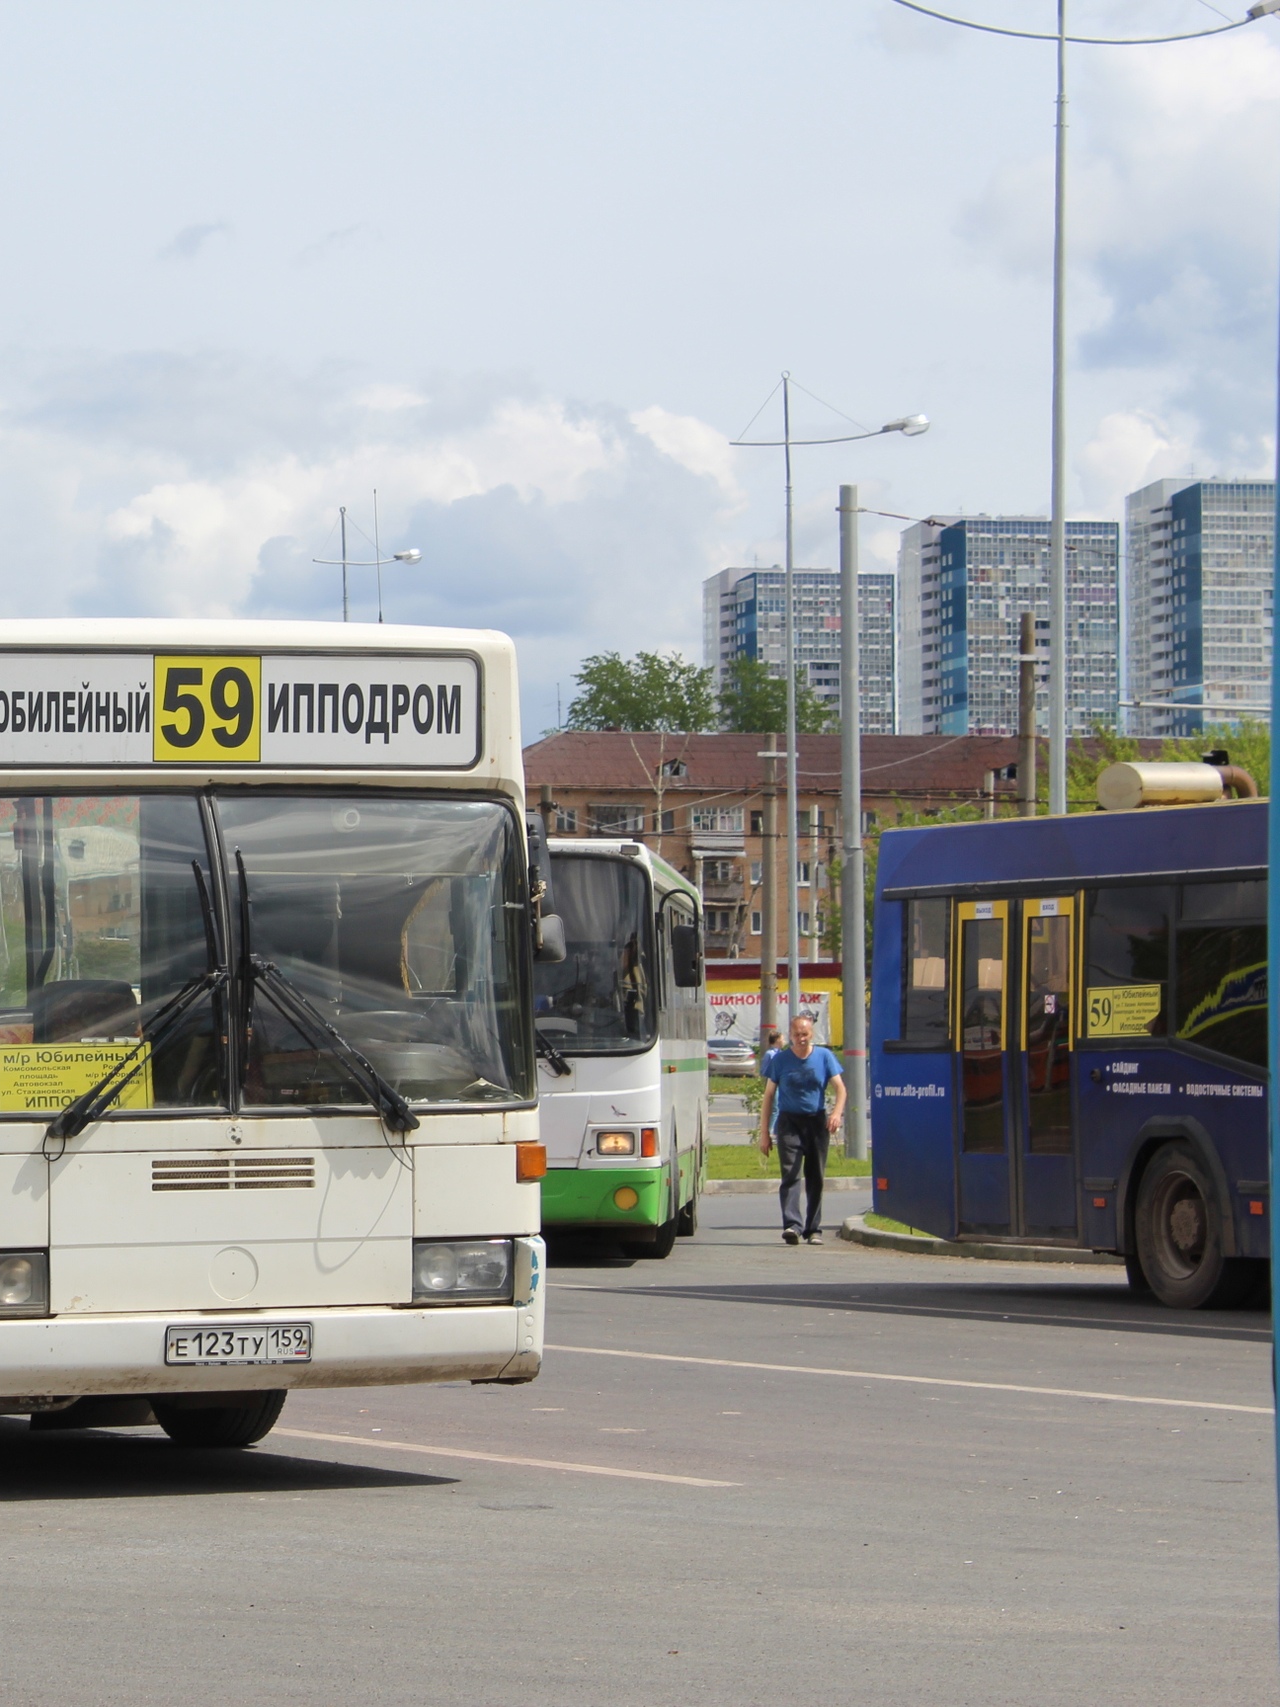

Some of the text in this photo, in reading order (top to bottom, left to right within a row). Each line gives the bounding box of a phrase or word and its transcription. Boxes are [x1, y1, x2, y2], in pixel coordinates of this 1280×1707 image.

[161, 667, 255, 748] 59
[268, 683, 461, 744] ИППОДРОМ
[710, 994, 822, 1006] ШИНОНАЖ
[1122, 989, 1158, 999] Юбилейный
[1090, 997, 1111, 1027] 59
[3, 1052, 31, 1066] м/р
[1112, 1062, 1139, 1075] САЙДИНГ
[885, 1084, 945, 1099] www.alta-profil.ru
[1112, 1083, 1171, 1095] ФАСАДНЫЕ ПАНЕЛИ
[1186, 1084, 1263, 1097] ВОДОСТОЧНЫЕ СИСТЕМЫ
[25, 1094, 121, 1108] ИППОМ
[176, 1329, 303, 1356] Е123ТУ 159
